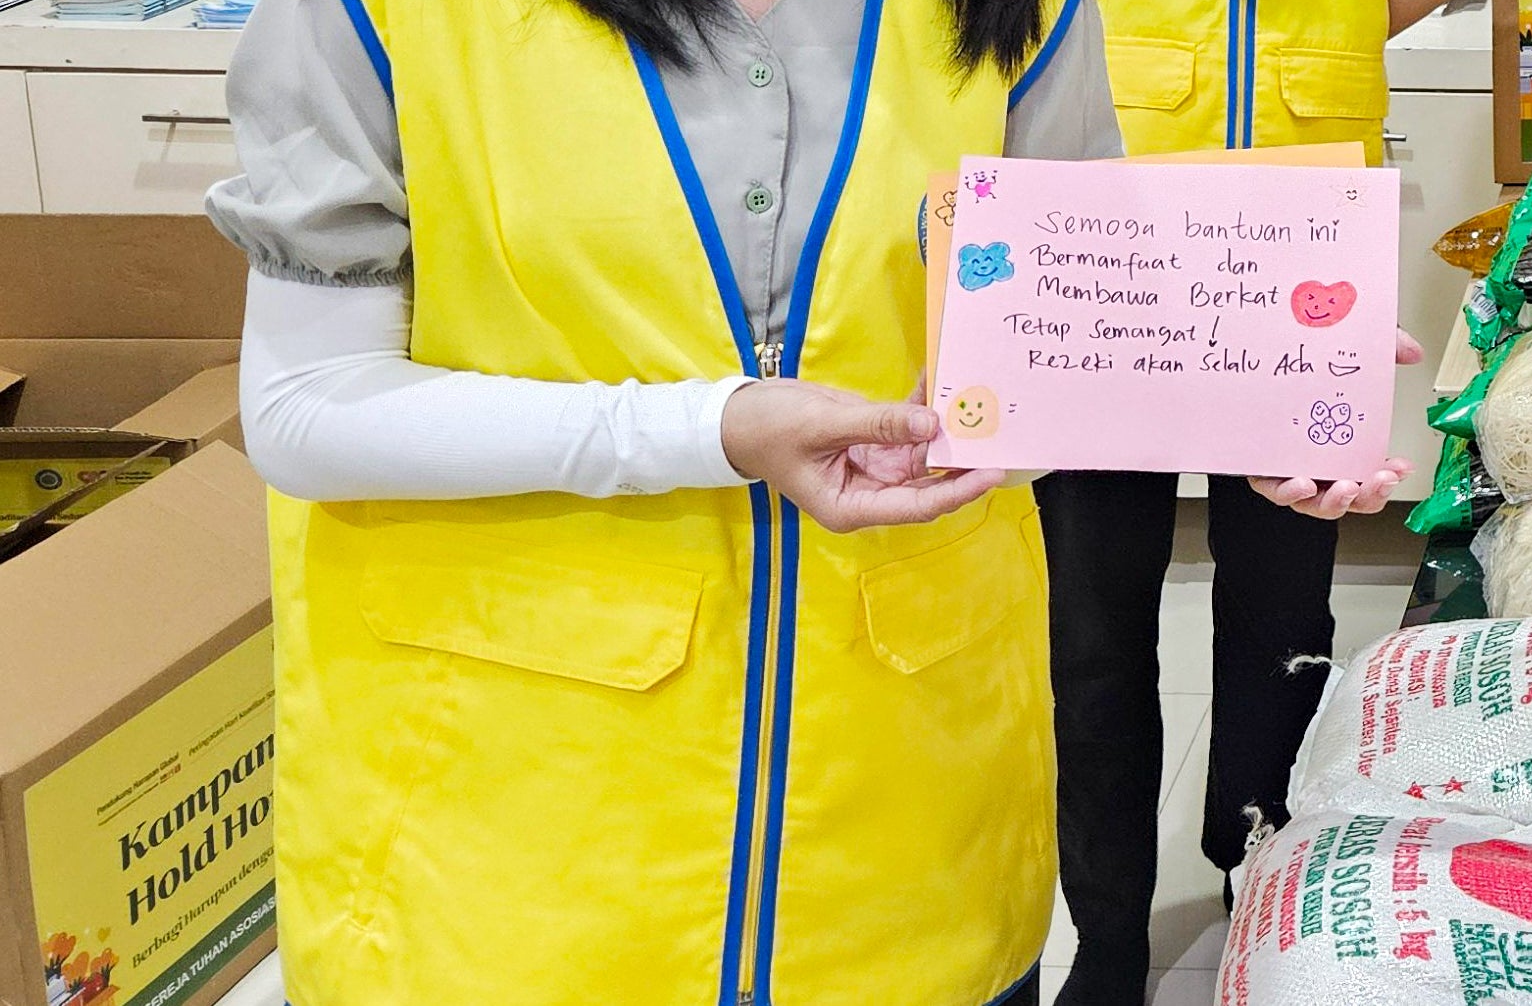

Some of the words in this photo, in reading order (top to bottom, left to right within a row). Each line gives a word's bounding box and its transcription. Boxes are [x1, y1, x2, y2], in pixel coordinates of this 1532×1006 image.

[1035, 211, 1155, 240] Semoga
[1184, 210, 1291, 243] bantuan
[1307, 217, 1340, 242] ini
[1218, 248, 1258, 274] dan
[1036, 276, 1159, 306] Membawa
[1189, 281, 1279, 308] Berkat
[1003, 313, 1071, 341] Tetap
[1133, 353, 1183, 373] akan
[1273, 344, 1314, 375] Ada
[126, 824, 219, 926] Hold
[222, 794, 275, 852] Ho
[132, 914, 184, 970] Berbagi
[184, 874, 238, 926] Harapan
[190, 936, 228, 978] TUHAN
